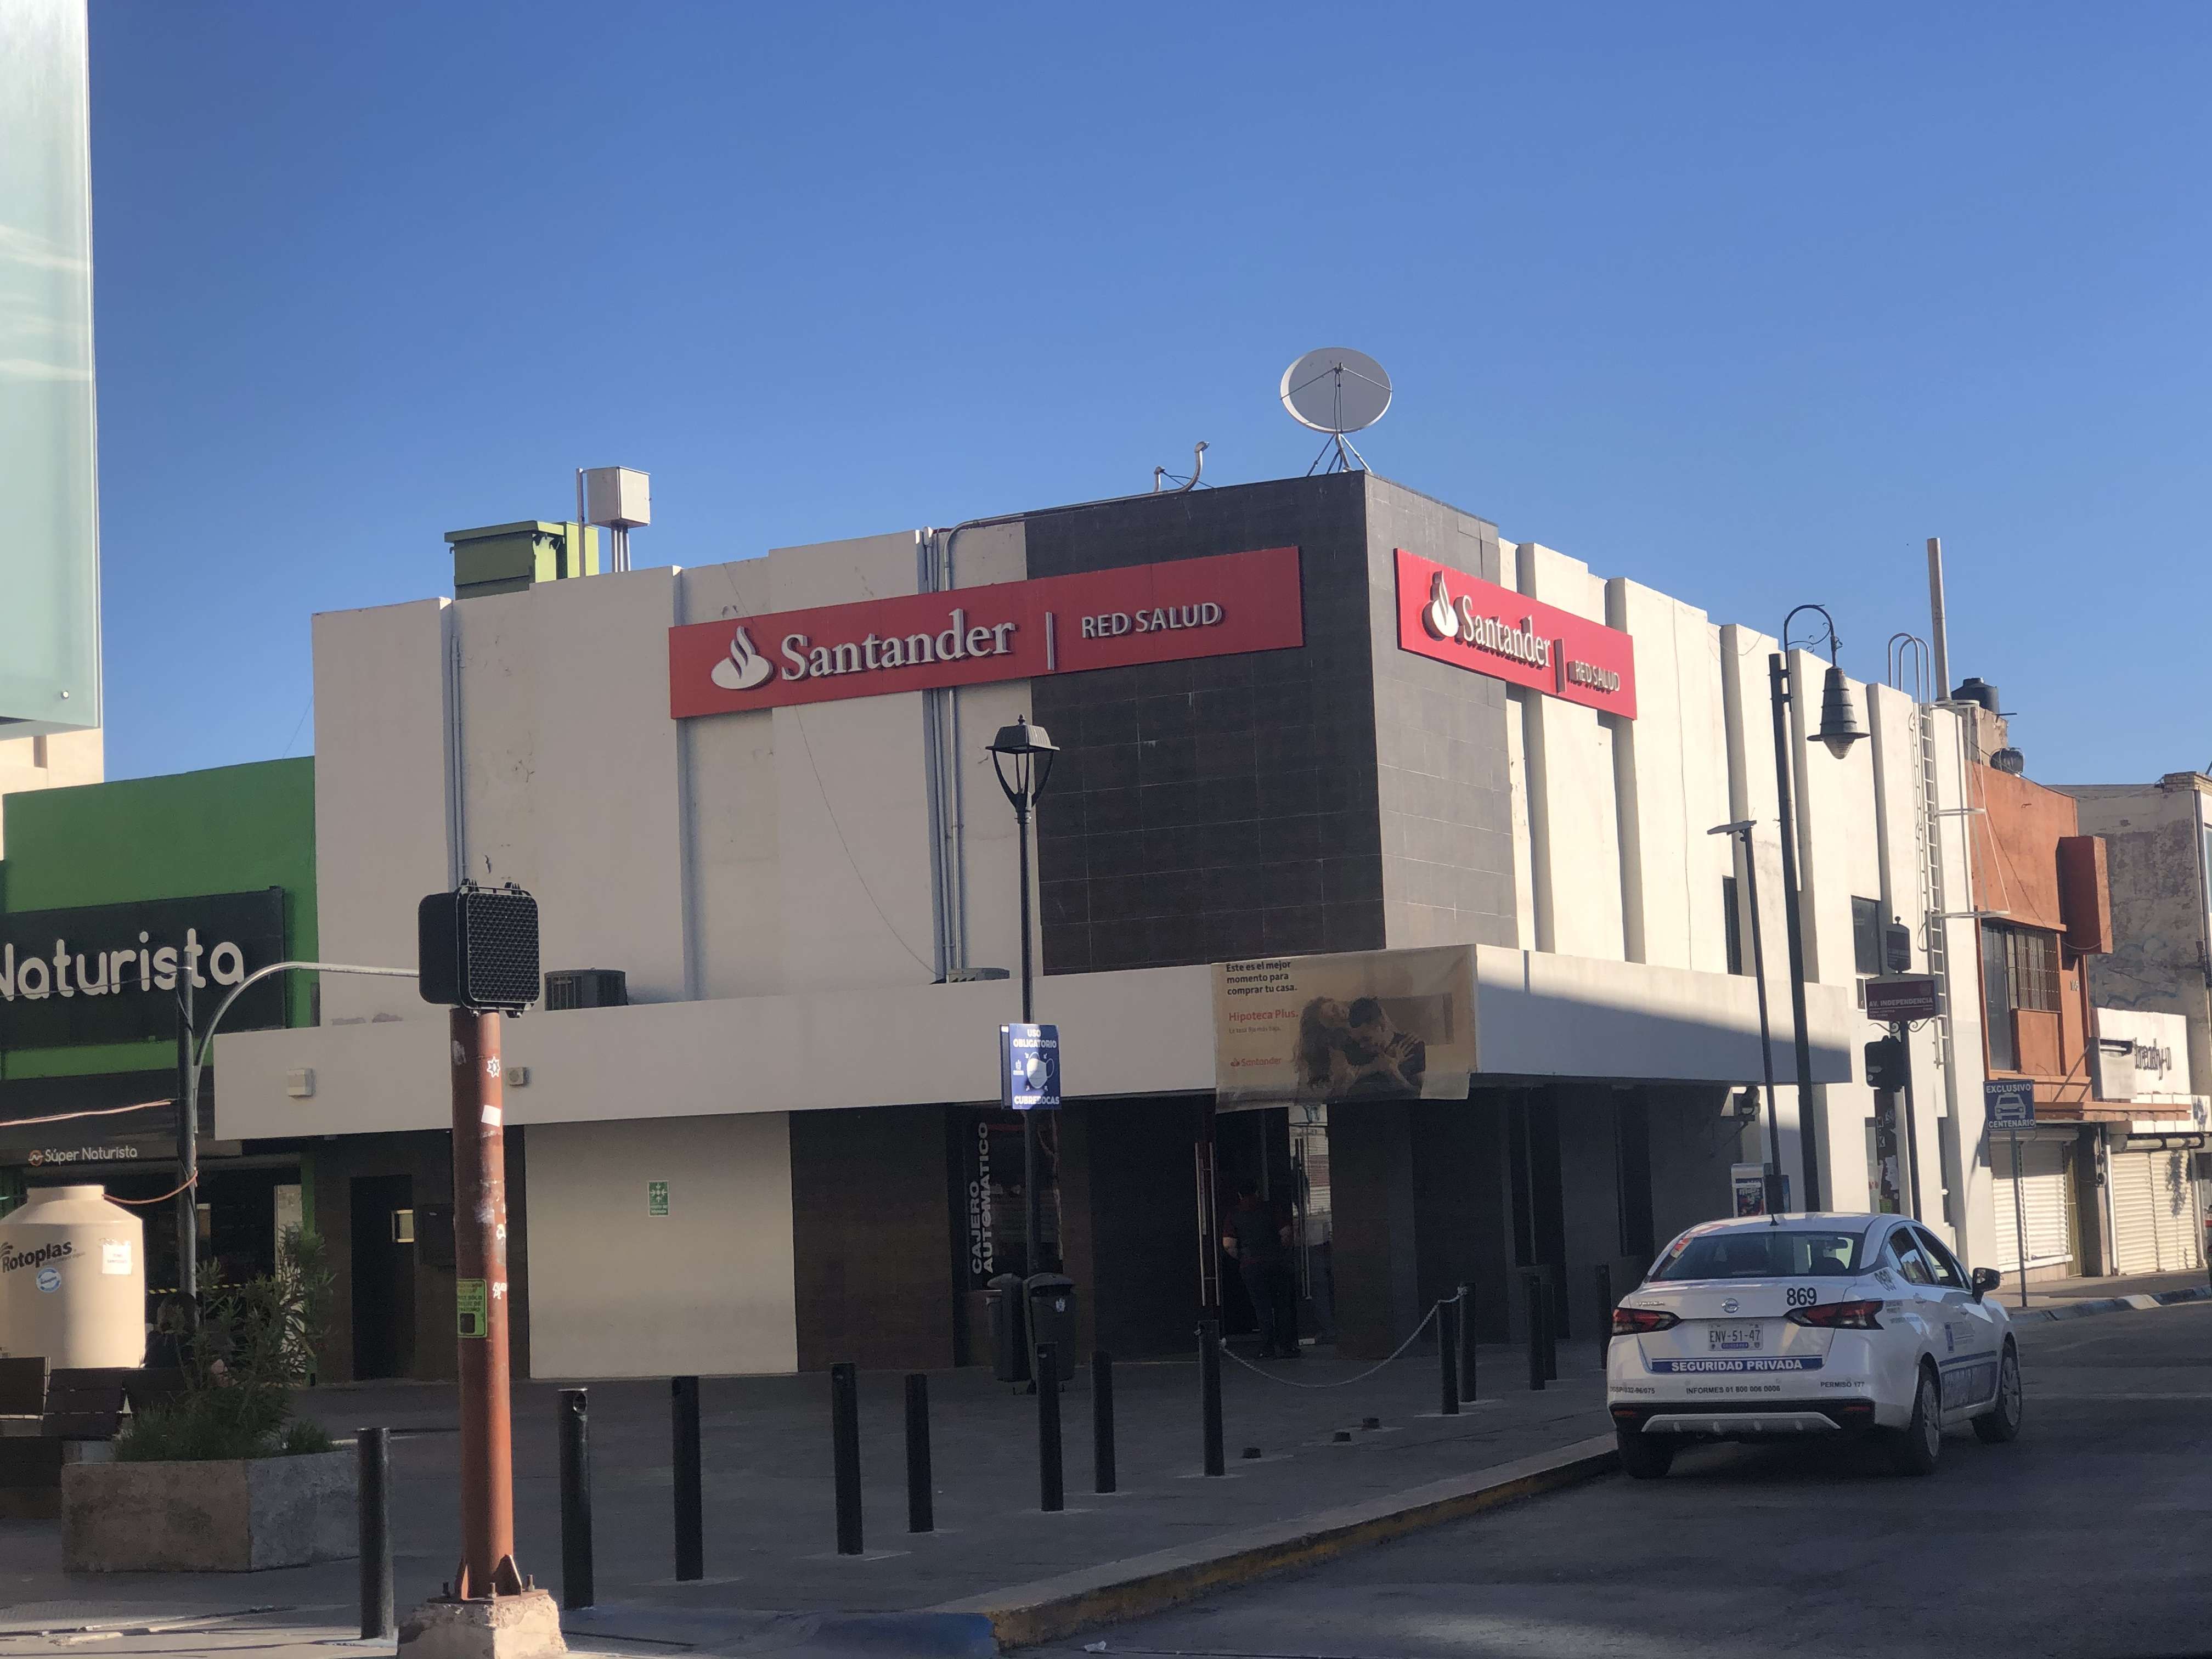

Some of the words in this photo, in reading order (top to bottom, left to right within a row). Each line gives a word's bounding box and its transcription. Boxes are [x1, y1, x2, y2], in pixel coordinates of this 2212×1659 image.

[1081, 612, 1131, 639] RED
[1135, 602, 1222, 632] SALUD
[1462, 595, 1551, 668] Santander
[781, 608, 1015, 680] Santander
[1575, 660, 1592, 684] RED
[1593, 665, 1621, 692] SALUD
[1226, 963, 1244, 972] Este
[1256, 961, 1264, 970] el
[1266, 960, 1291, 970] mejor
[1227, 974, 1268, 984] momento
[1270, 973, 1289, 983] para
[1227, 986, 1263, 996] comprar
[1881, 997, 1933, 1006] INDEPENDENCIA
[1229, 1012, 1273, 1023] Hipoteca
[1275, 1009, 1299, 1019] Plus.
[1027, 1029, 1041, 1037] USO
[1013, 1038, 1057, 1048] OBLIGATORIO
[1241, 1057, 1282, 1066] Santander
[1986, 1084, 2031, 1093] EXCLUSIVO
[1014, 1096, 1060, 1105] CUBREBOCAS
[1988, 1119, 2035, 1128] CENTENARIO
[44, 1148, 80, 1166] Súper
[82, 1145, 138, 1160] Naturista
[978, 1122, 994, 1273] AUTOMATICO
[969, 1181, 983, 1274] CAJERO
[2, 1241, 72, 1273] Rotoplas
[1786, 1287, 1817, 1306] 869
[1709, 1329, 1760, 1342] ENV-51-47
[1672, 1361, 1743, 1372] SEGURIDAD
[1747, 1359, 1803, 1370] PRIVADA
